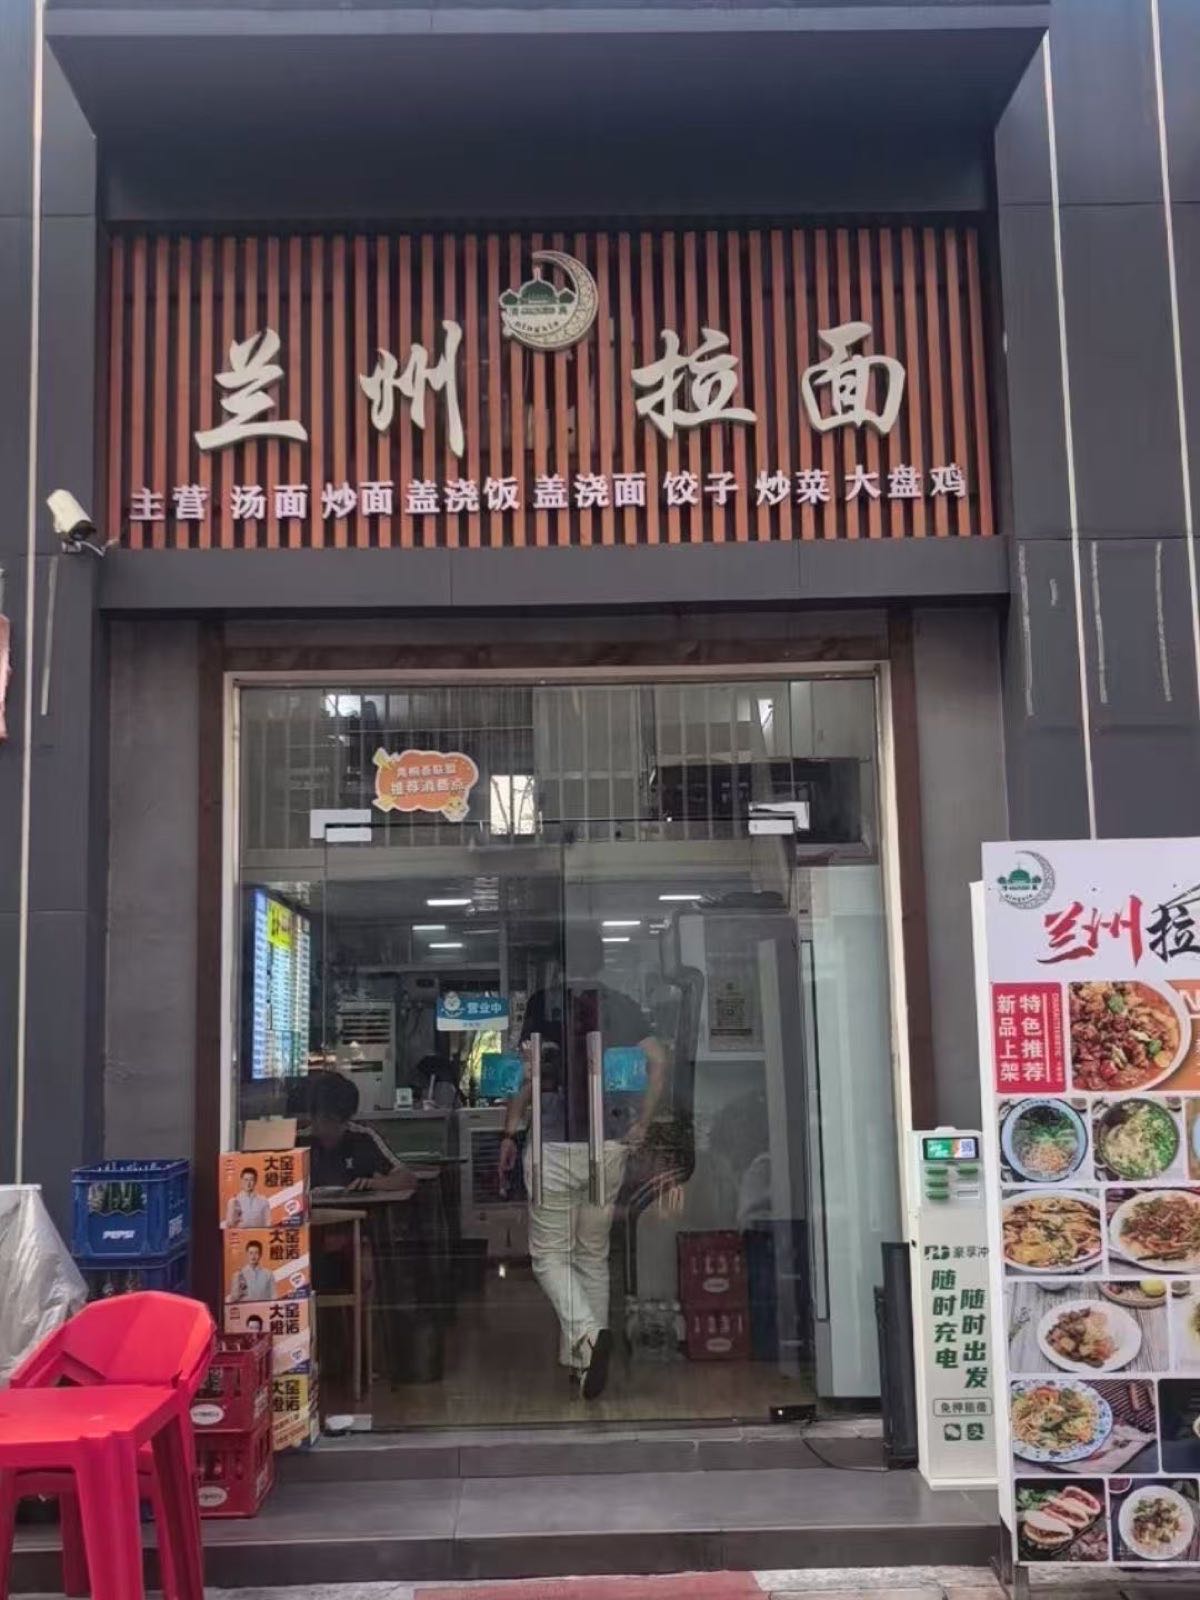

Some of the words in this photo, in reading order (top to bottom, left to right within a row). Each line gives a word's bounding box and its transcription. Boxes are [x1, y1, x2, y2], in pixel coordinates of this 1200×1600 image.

[194, 319, 465, 459] 兰州
[631, 320, 906, 440] 拉面
[129, 486, 210, 521] 主营
[230, 483, 309, 520] 汤面
[320, 480, 394, 519] 炒面
[405, 477, 520, 515] 盖浇饭
[533, 472, 647, 509] 盖浇面
[663, 470, 739, 506] 饺子
[754, 468, 831, 506] 炒菜
[845, 463, 969, 500] 大盘鸡
[467, 1002, 502, 1014] 营业中
[996, 994, 1020, 1082] 新品上架
[1020, 994, 1045, 1082] 特色推荐
[931, 1269, 959, 1369] 随时充电
[960, 1288, 988, 1389] 随时出发
